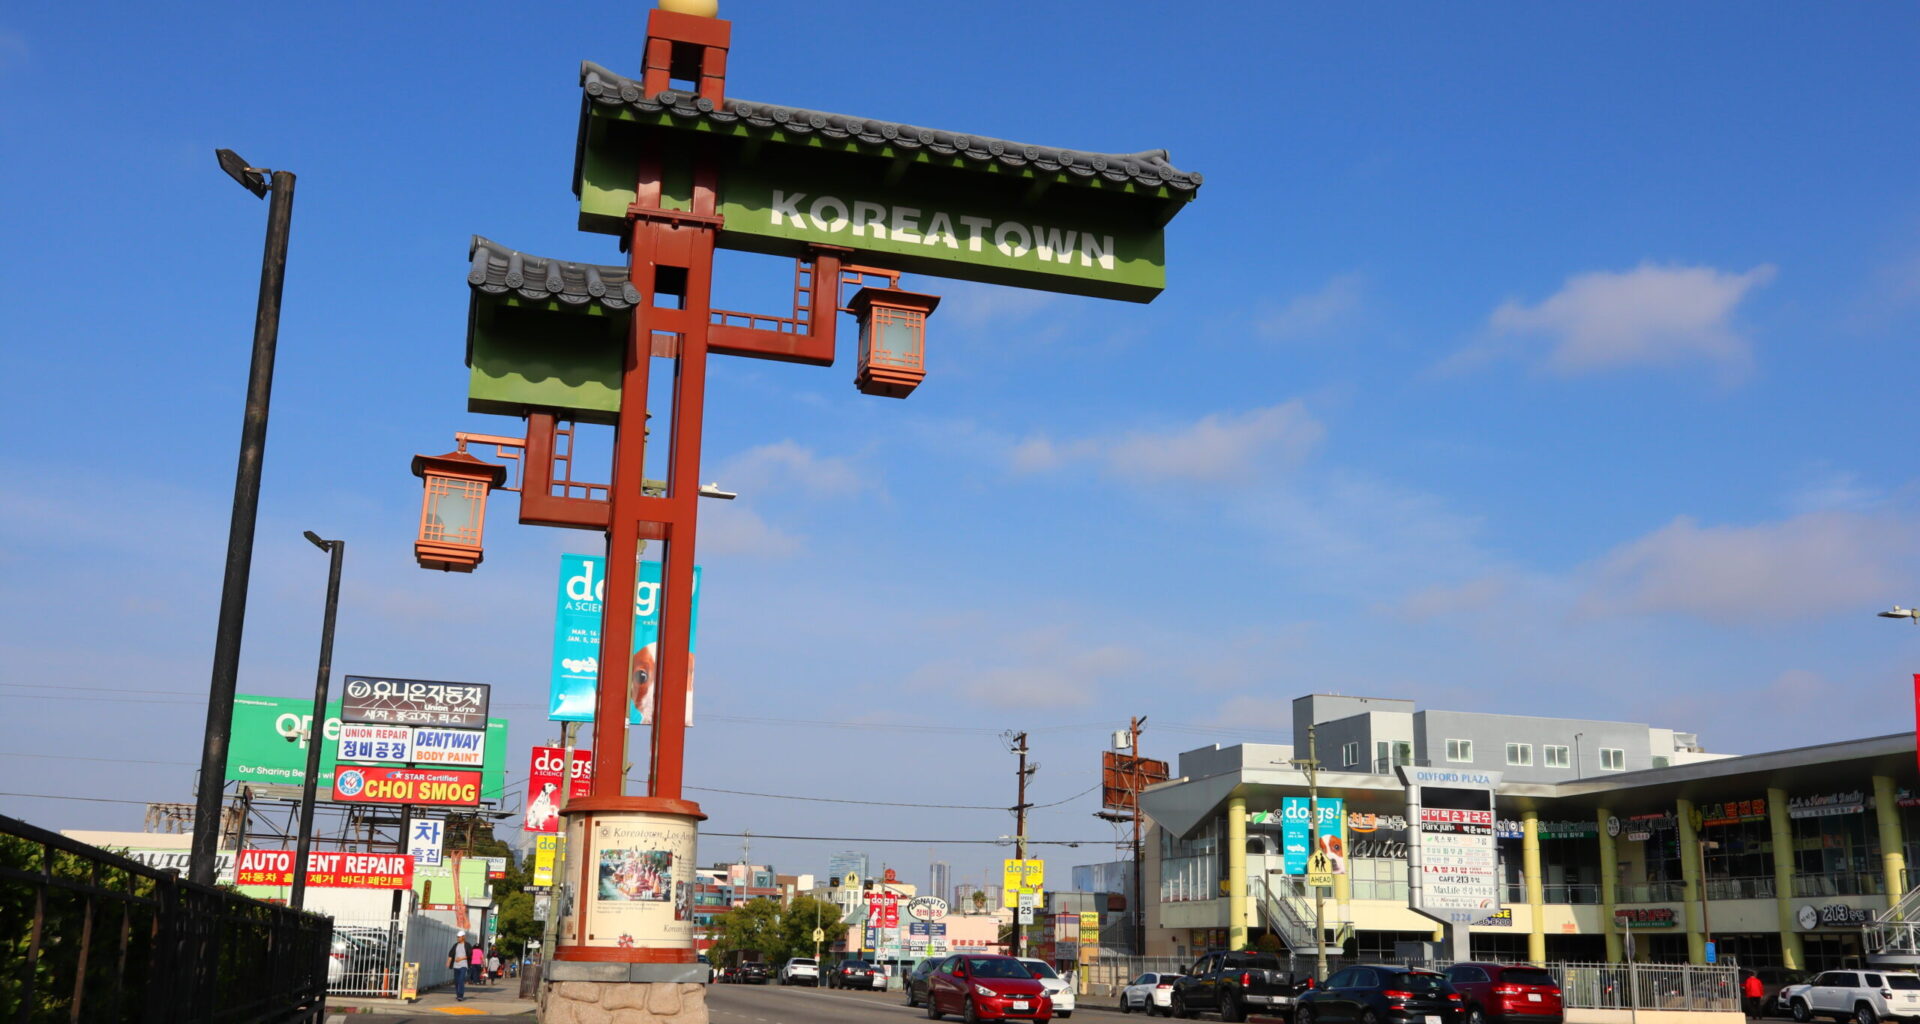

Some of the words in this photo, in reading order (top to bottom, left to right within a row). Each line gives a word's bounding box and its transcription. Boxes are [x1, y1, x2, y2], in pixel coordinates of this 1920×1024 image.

[771, 189, 1115, 270] KOREATOWN
[345, 728, 372, 738] UNION
[376, 729, 407, 739] REPAIR
[416, 731, 481, 751] DENTWAY
[344, 741, 406, 759] 정비공장
[416, 751, 444, 761] BODY
[447, 752, 479, 763] PAINT
[239, 765, 254, 773] Our
[256, 766, 290, 777] Sharing
[427, 774, 458, 782] Certified
[1417, 771, 1458, 782] OLYFORD
[1461, 773, 1490, 784] PLAZA
[364, 780, 413, 799] CHOI
[418, 782, 476, 802] SMOG
[1285, 799, 1340, 824] dogs!
[414, 821, 441, 844] 차
[411, 848, 440, 864] 흠집
[241, 853, 289, 871] AUTO
[307, 854, 341, 872] ENT
[345, 856, 405, 875] REPAIR
[1006, 861, 1042, 876] dogs!
[240, 873, 276, 883] 자동차
[310, 875, 334, 884] 제거
[341, 876, 365, 884] 바디
[368, 877, 404, 886] 페인트
[1456, 876, 1469, 885] 213
[1020, 906, 1032, 915] 25
[1823, 904, 1848, 922] 213
